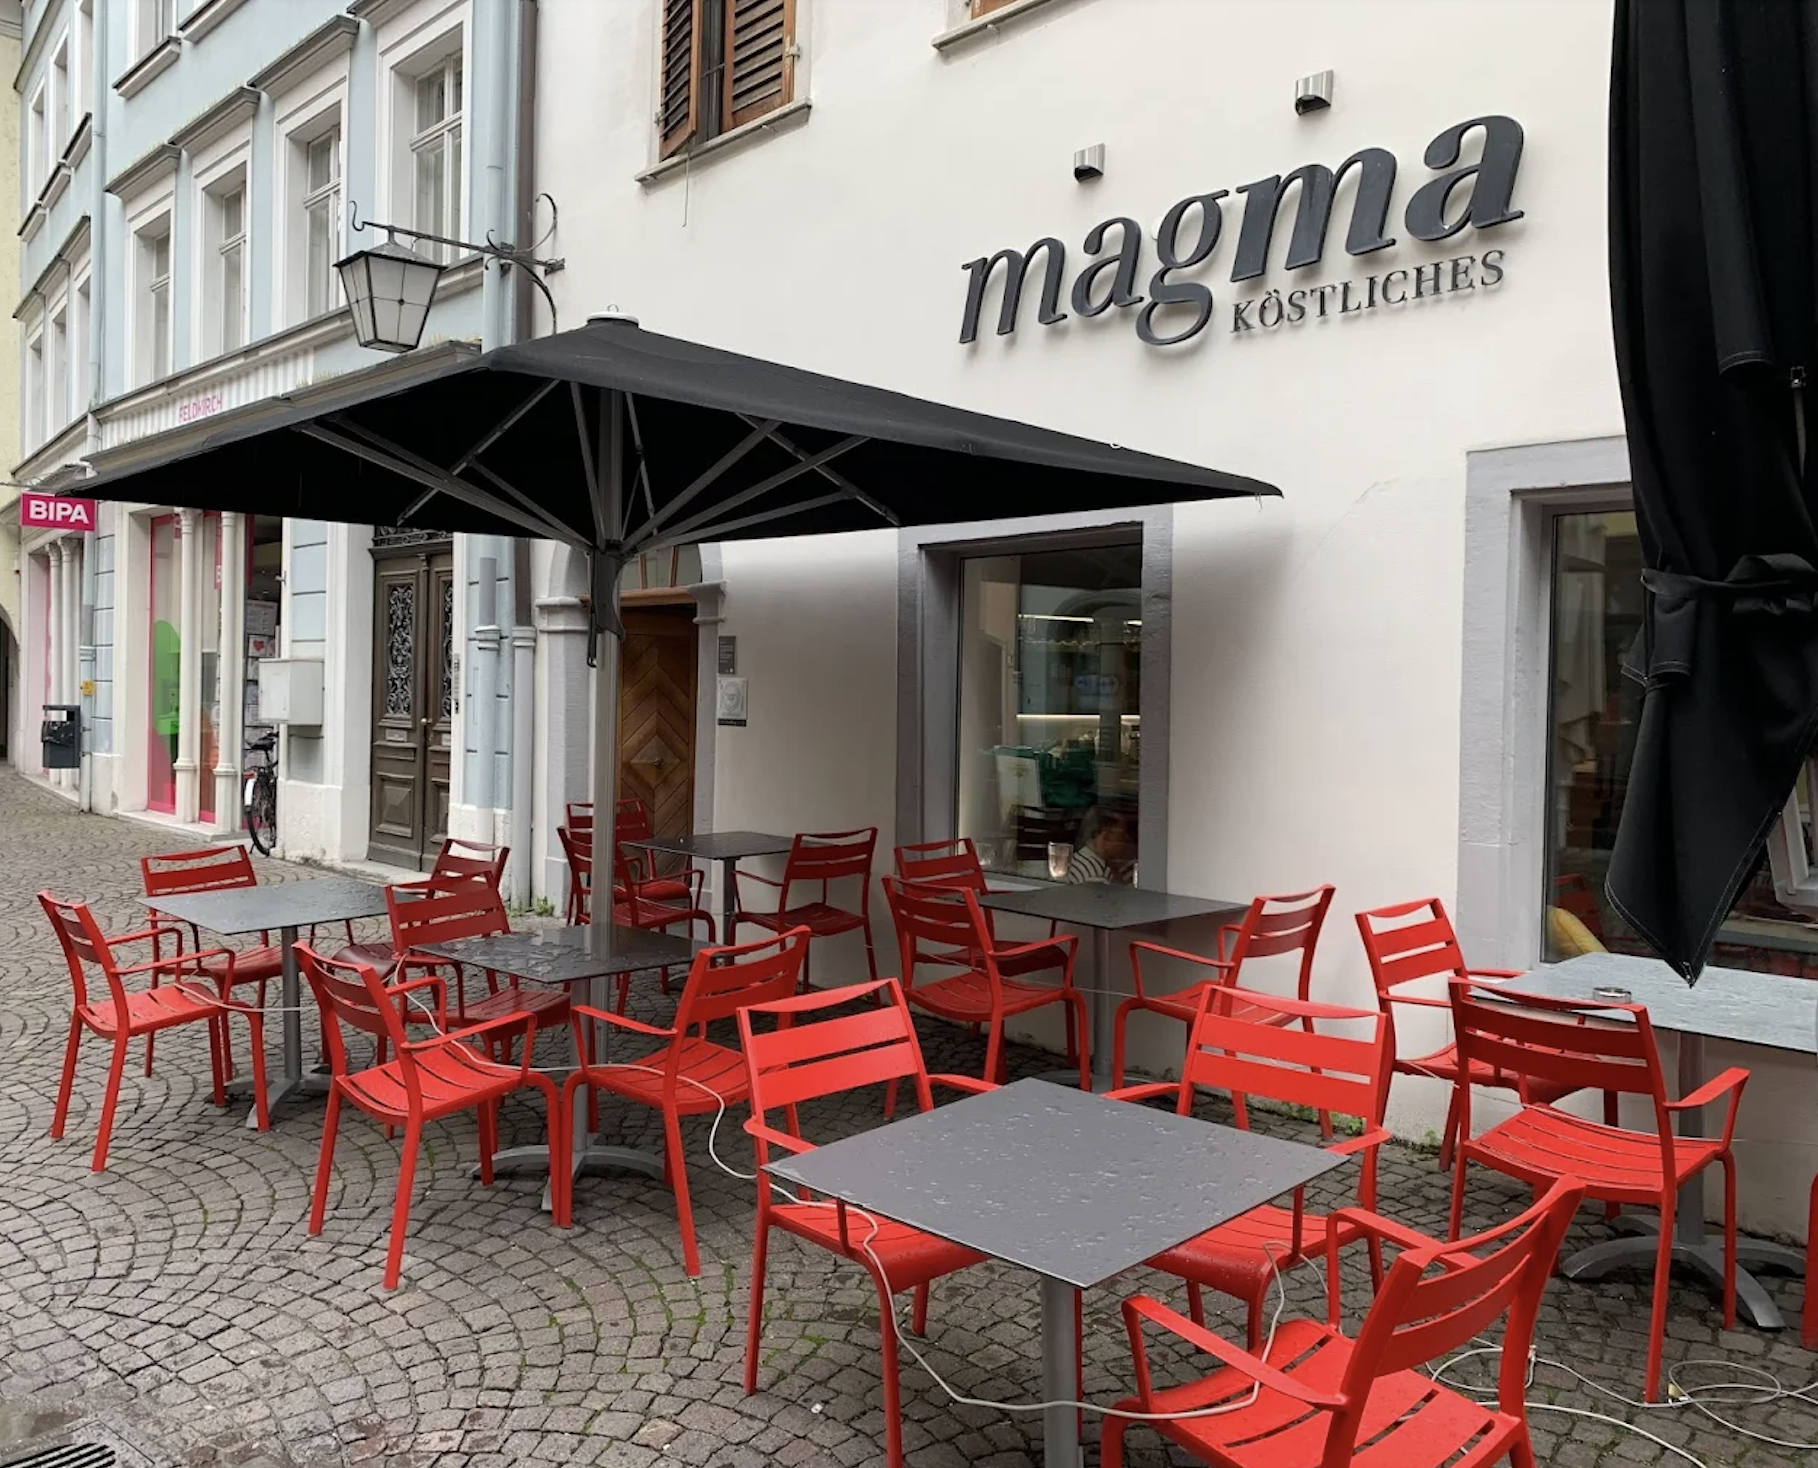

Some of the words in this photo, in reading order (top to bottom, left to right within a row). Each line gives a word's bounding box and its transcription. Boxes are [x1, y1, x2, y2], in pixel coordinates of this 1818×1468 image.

[959, 114, 1525, 346] magma
[1231, 250, 1505, 333] KÖSTLICHES
[179, 392, 223, 423] FELDKIRCH
[29, 499, 90, 525] BIPA
